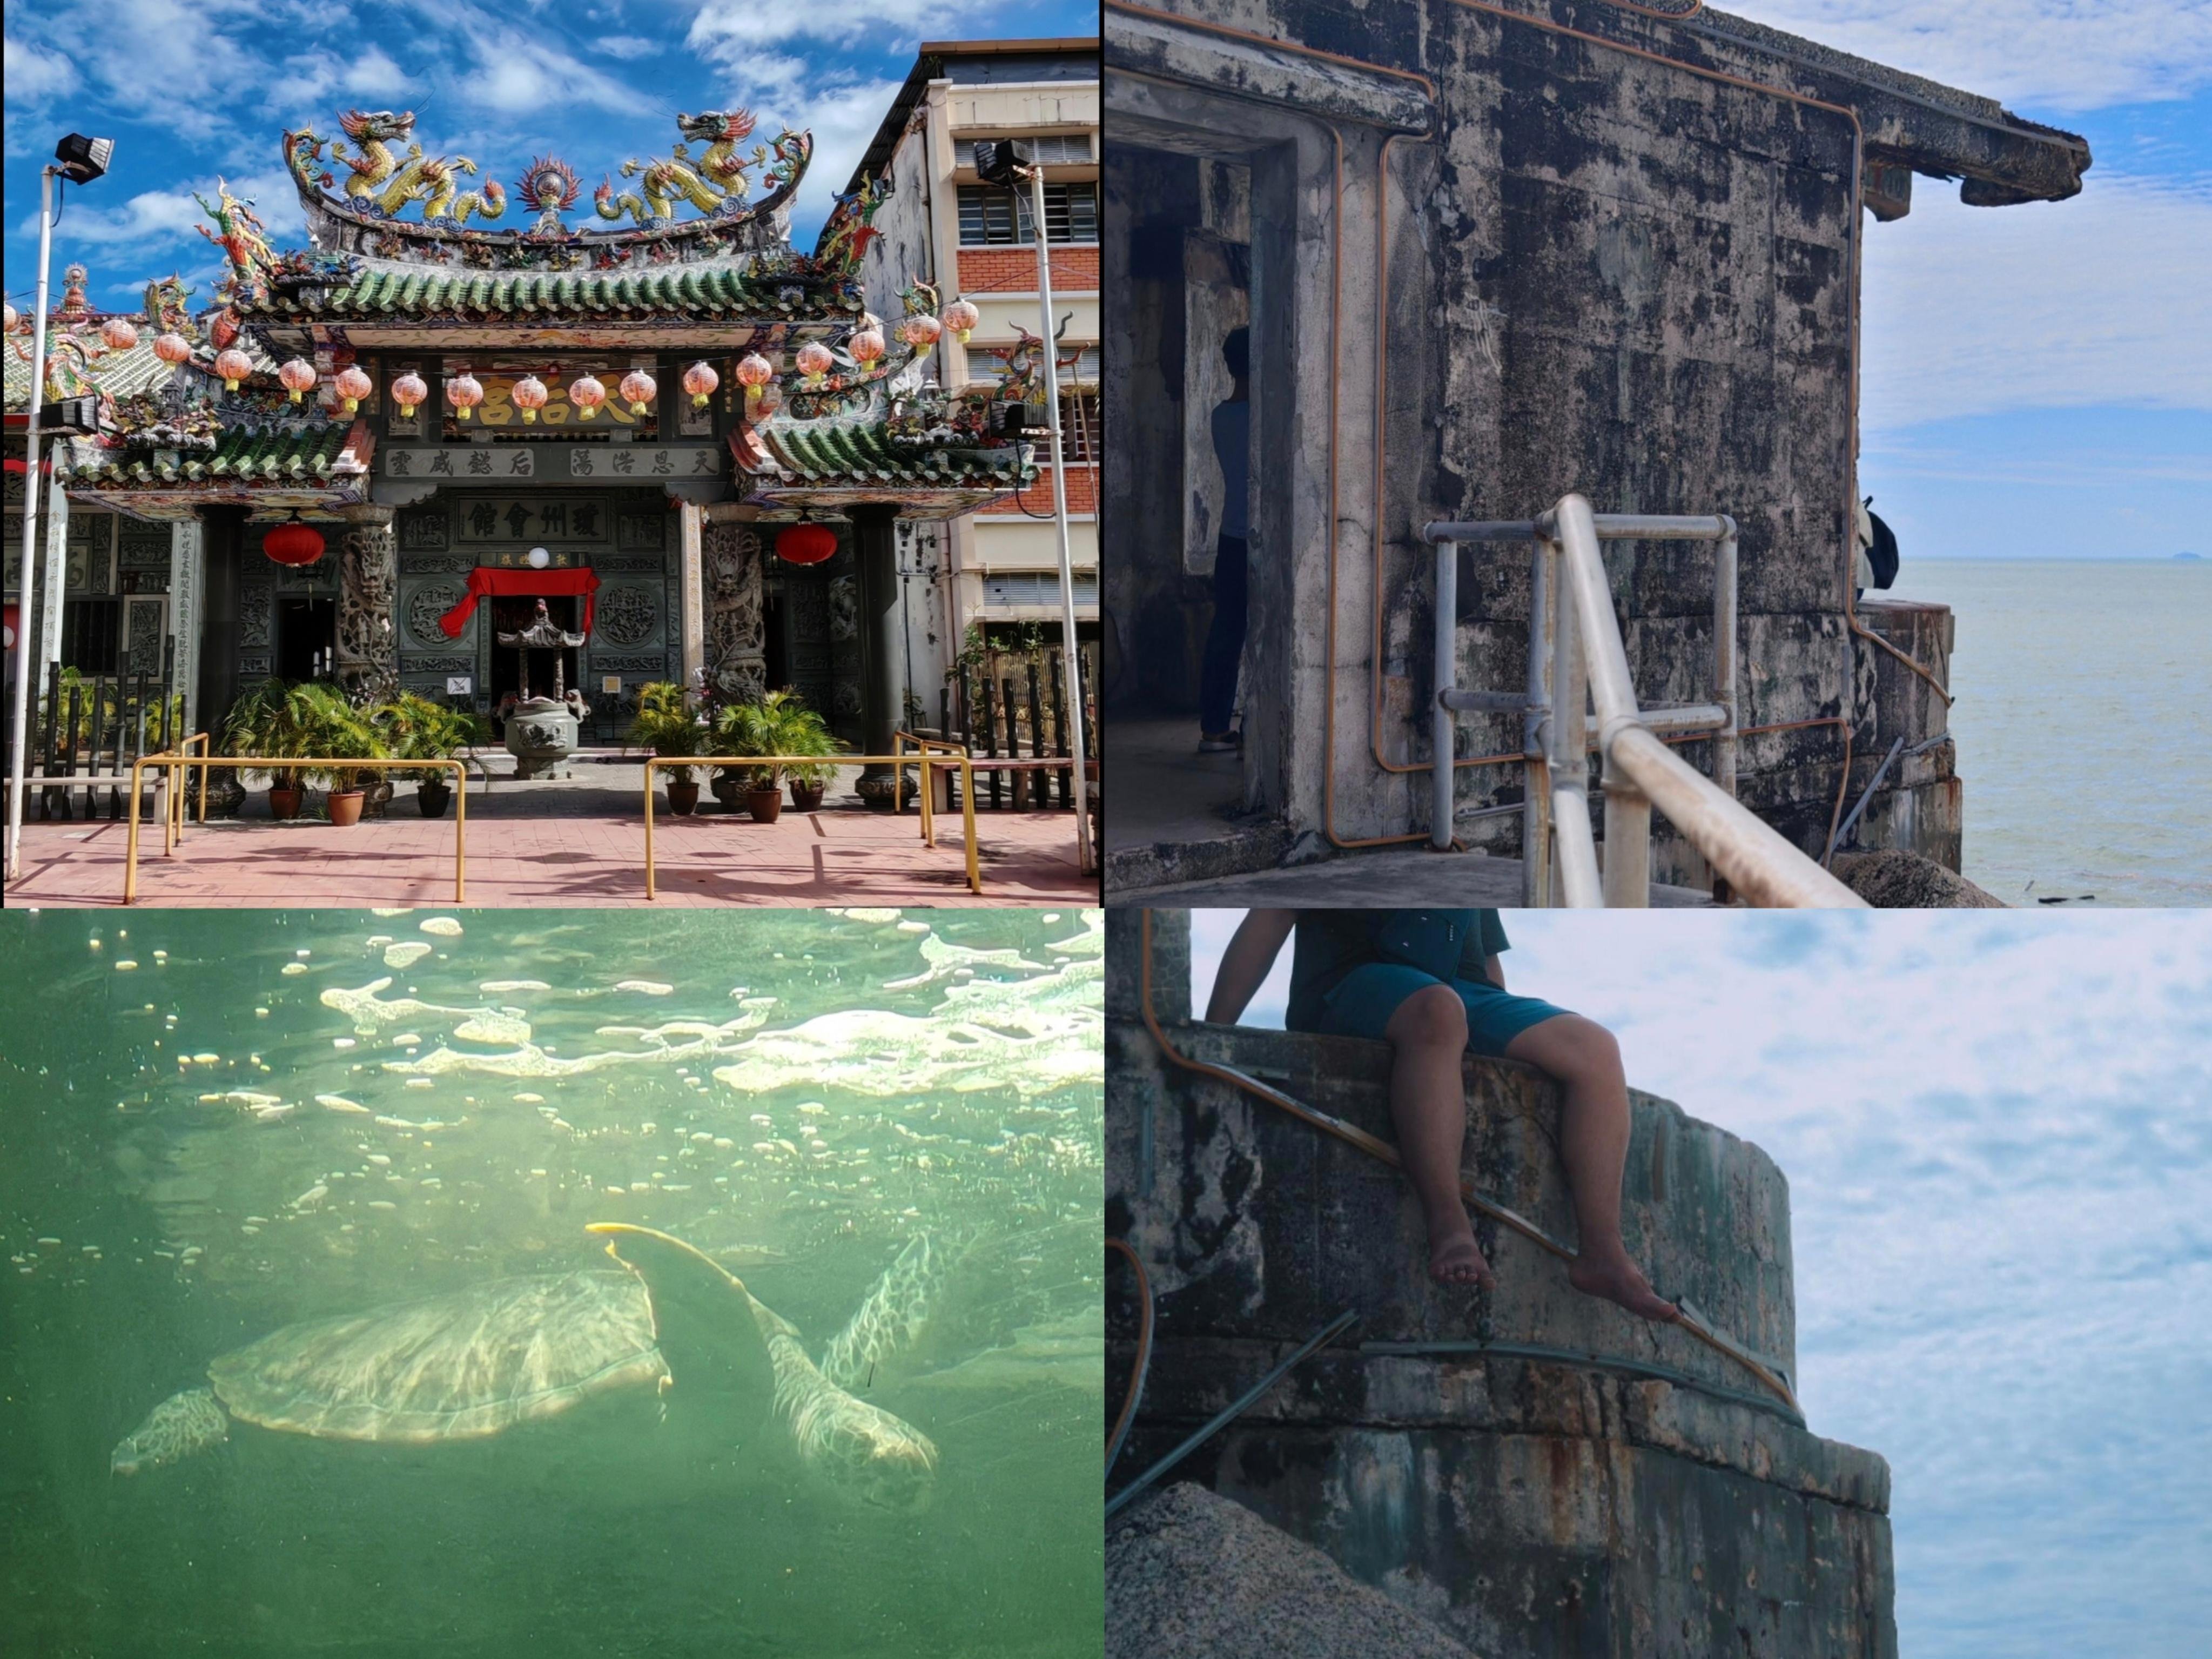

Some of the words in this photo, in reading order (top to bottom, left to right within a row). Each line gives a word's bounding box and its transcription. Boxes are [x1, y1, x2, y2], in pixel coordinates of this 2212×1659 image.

[572, 448, 718, 476] 天恩浩蕩
[468, 501, 600, 539] 瓊州會館
